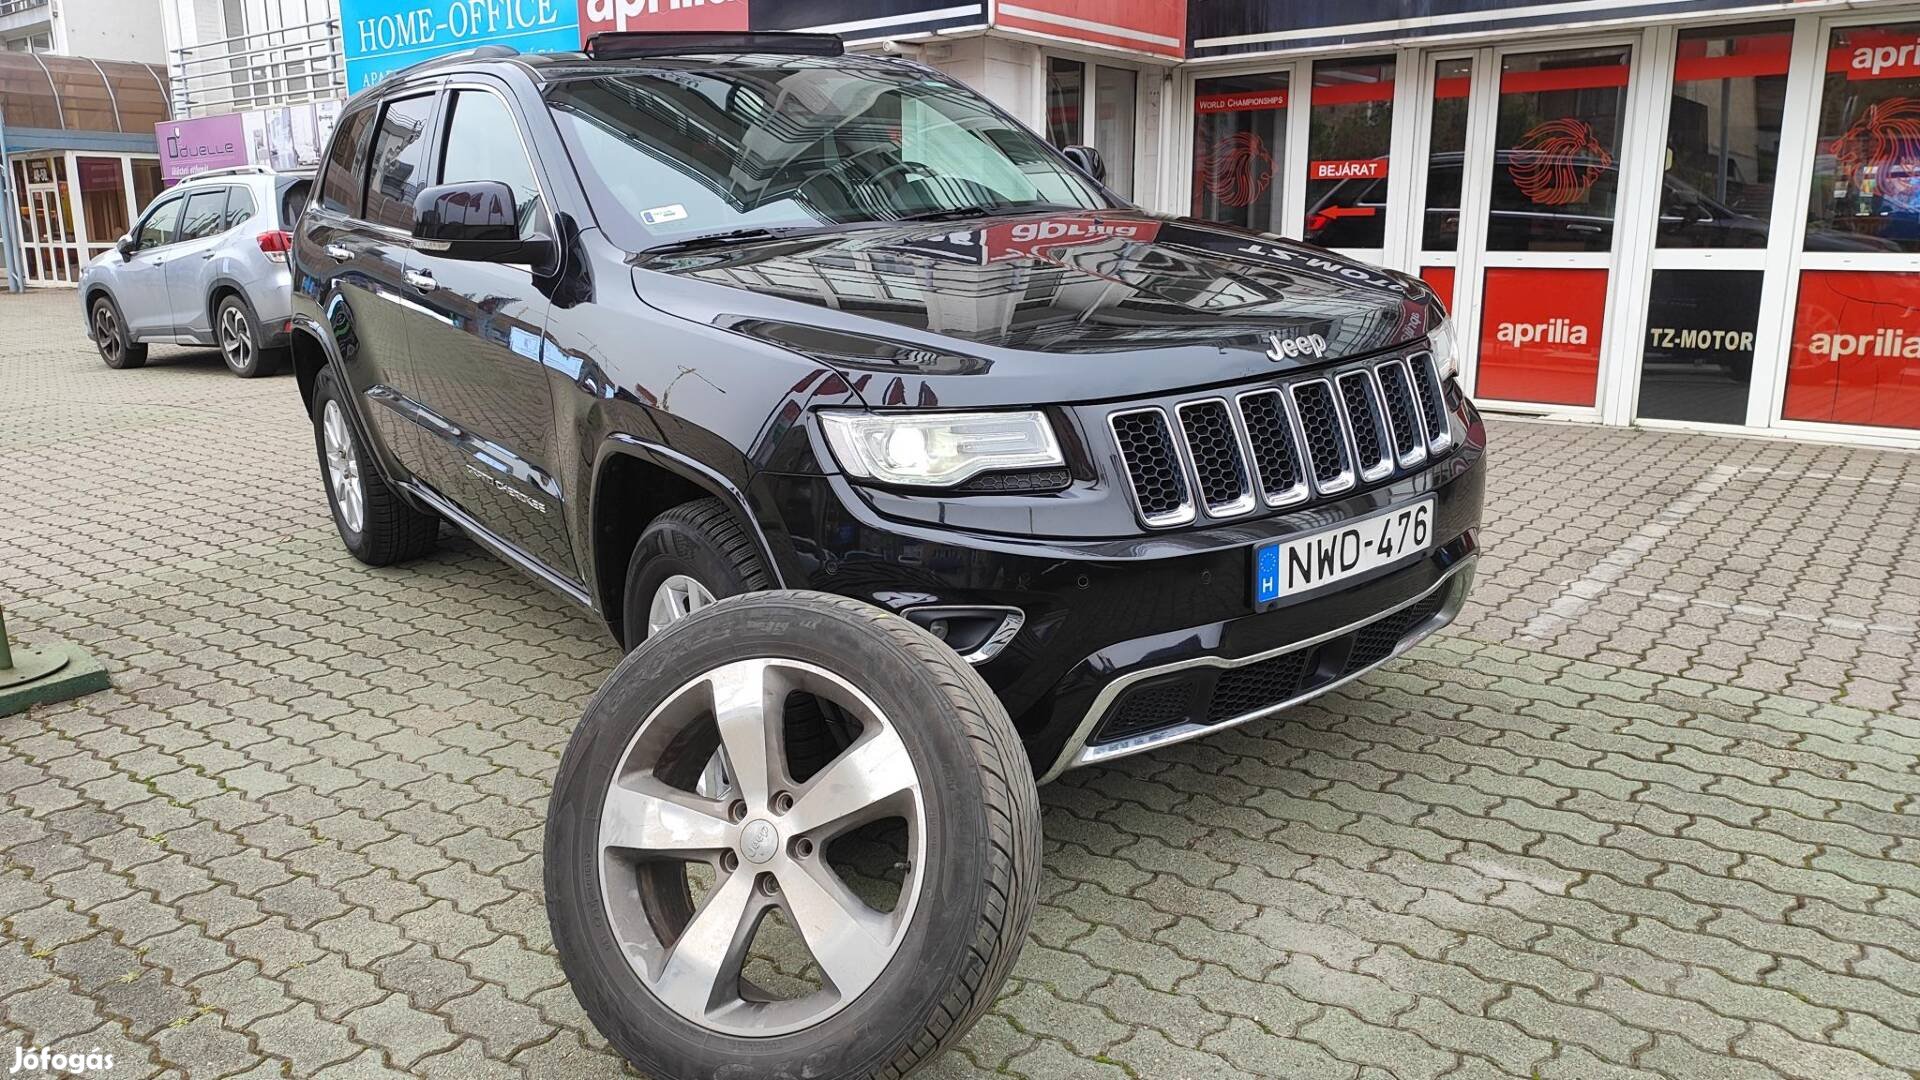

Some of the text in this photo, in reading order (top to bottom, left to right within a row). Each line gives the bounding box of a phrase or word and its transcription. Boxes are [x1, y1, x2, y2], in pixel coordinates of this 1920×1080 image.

[358, 0, 558, 52] HOME-OFFICE
[1318, 161, 1378, 176] BEJÁRAT
[1497, 318, 1588, 347] aprilia
[1650, 328, 1754, 351] TZ-MOTOR
[1808, 328, 1920, 361] aprilia
[1266, 333, 1327, 362] Jeep
[1262, 505, 1428, 593] H NWD-476
